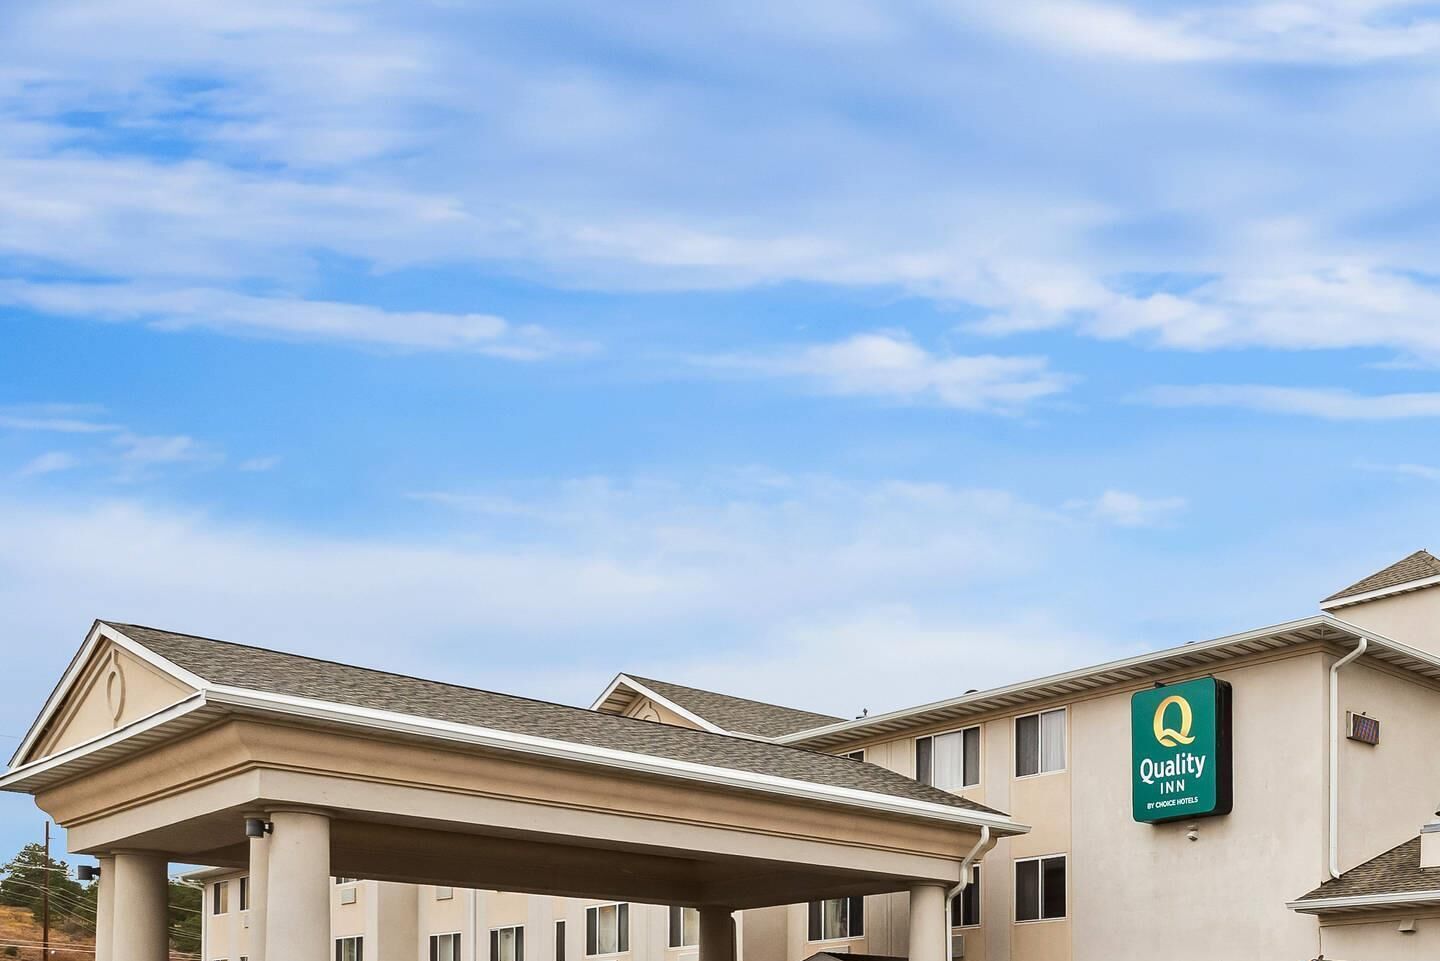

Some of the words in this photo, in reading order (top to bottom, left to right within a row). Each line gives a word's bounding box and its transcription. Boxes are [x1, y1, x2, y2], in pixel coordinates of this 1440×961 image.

[1153, 695, 1195, 747] Q
[1140, 752, 1206, 784] Quality
[1160, 779, 1185, 795] INN
[1155, 799, 1176, 808] CHOICE
[1177, 797, 1198, 805] HOTELS
